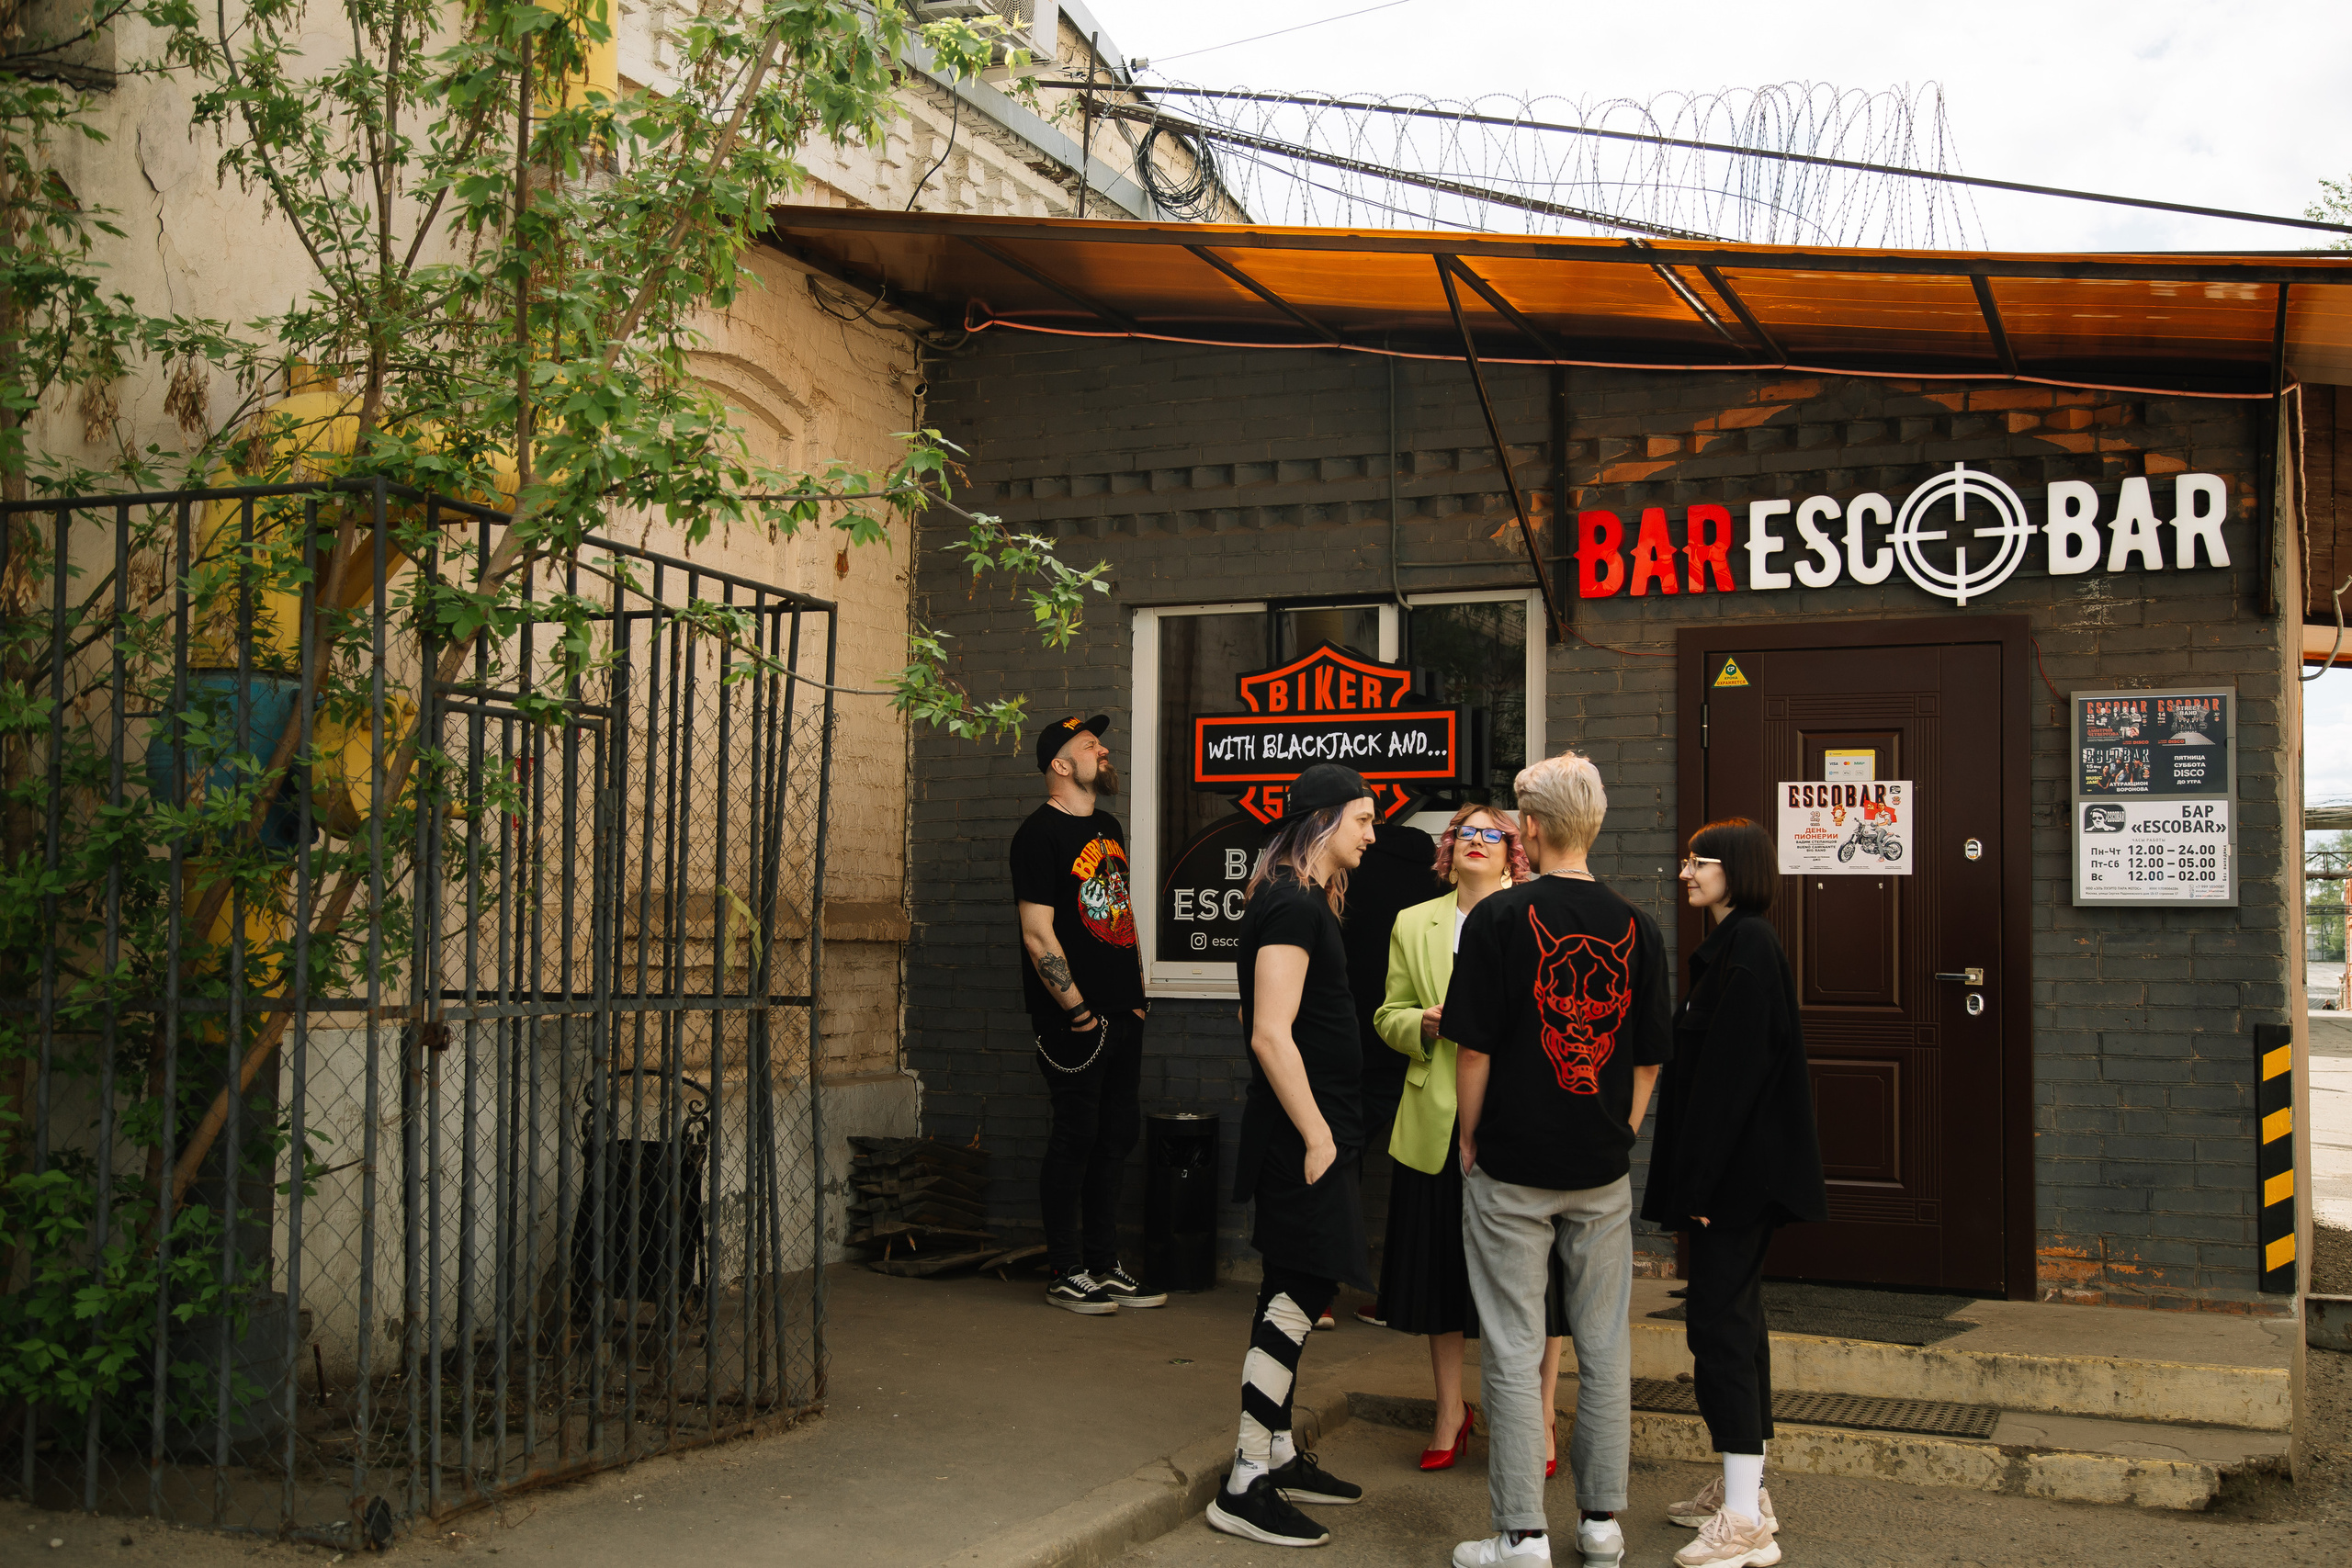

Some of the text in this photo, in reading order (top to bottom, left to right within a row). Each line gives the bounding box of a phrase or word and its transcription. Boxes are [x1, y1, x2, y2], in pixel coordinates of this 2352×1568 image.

[1573, 504, 1738, 599] BAR
[1269, 664, 1382, 713] BIKER
[2086, 701, 2147, 714] ESCOBAR
[1208, 730, 1447, 761] WITH BLACKJACK AND...
[2174, 769, 2205, 777] DISCO
[1788, 784, 1886, 808] ESCOBAR
[2182, 806, 2213, 818] БАР
[2132, 820, 2226, 833] «ESCOBAR»
[2090, 847, 2120, 855] Пн-Чт
[2128, 845, 2164, 855] 12.00
[2178, 845, 2216, 855] 24.00
[2090, 860, 2120, 868] Пт-Сб
[2128, 858, 2164, 868] 12.00
[2178, 858, 2216, 868] 05.00
[2090, 873, 2103, 881] Вс
[2128, 871, 2164, 881] 12.00
[2178, 871, 2216, 881] 02.00
